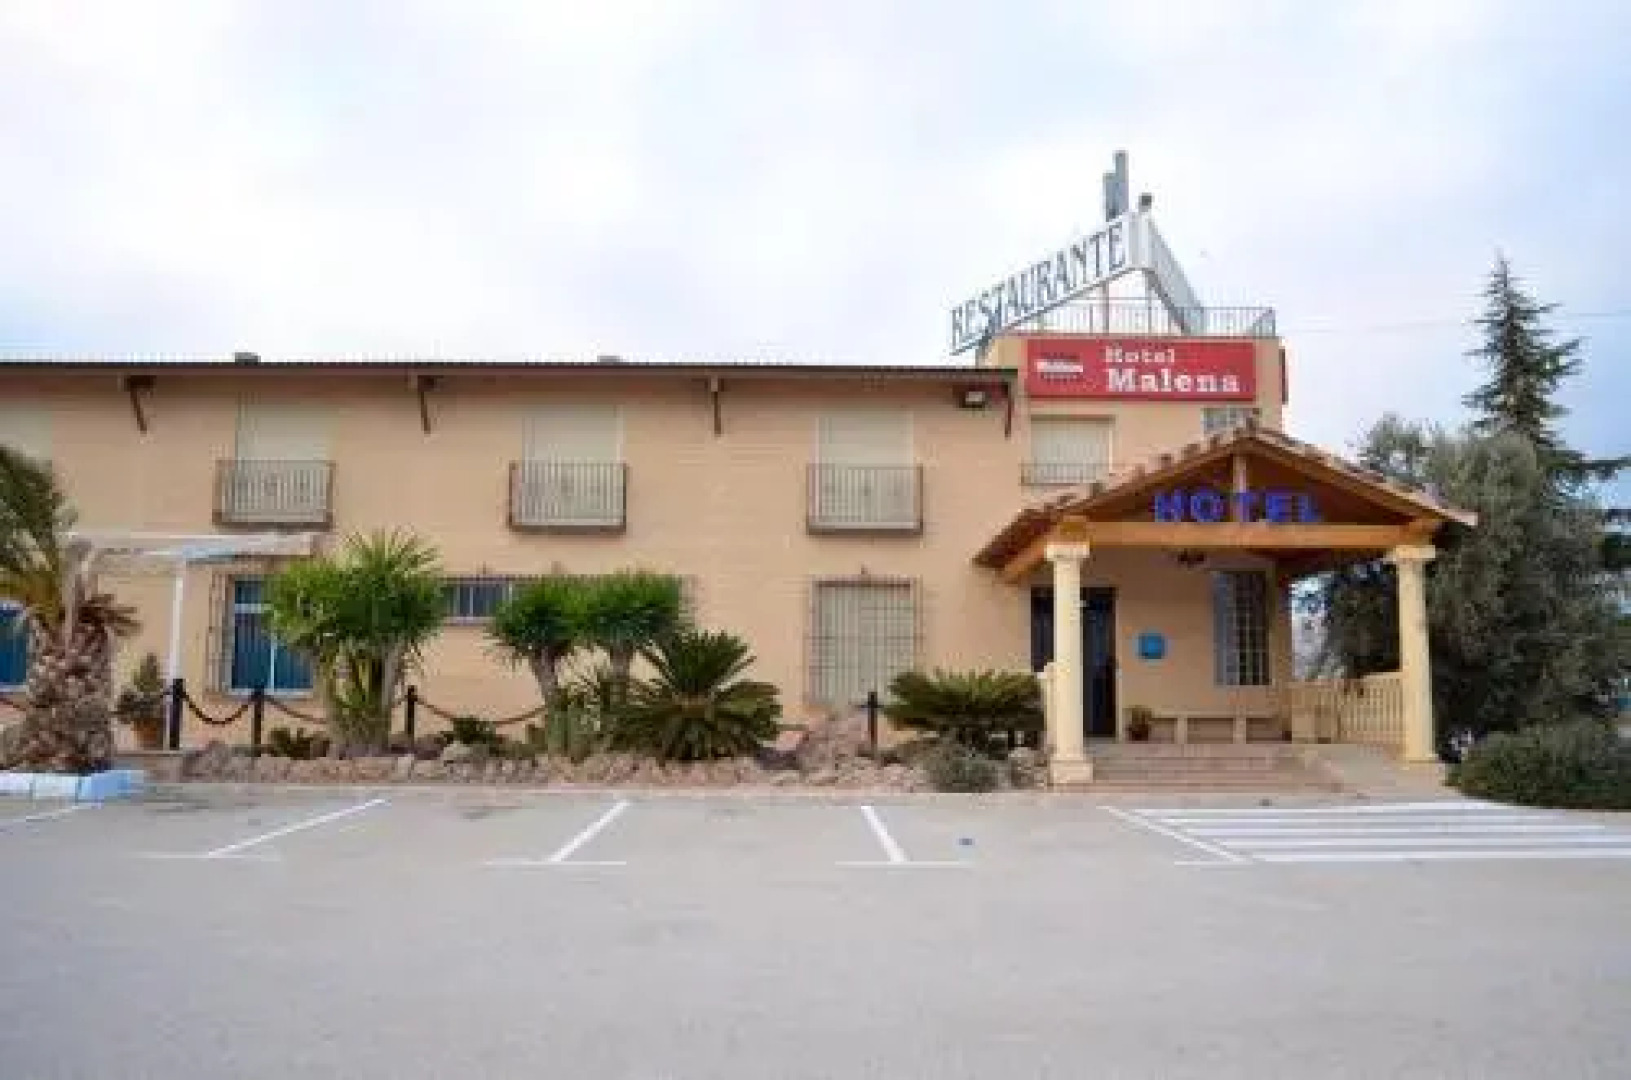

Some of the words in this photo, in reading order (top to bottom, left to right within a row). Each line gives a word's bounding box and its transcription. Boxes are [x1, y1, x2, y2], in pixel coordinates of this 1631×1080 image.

[950, 221, 1127, 351] RESTAURANTE
[1104, 346, 1175, 363] Hotel
[1106, 368, 1240, 392] Malena
[1154, 490, 1324, 523] HOTEL
